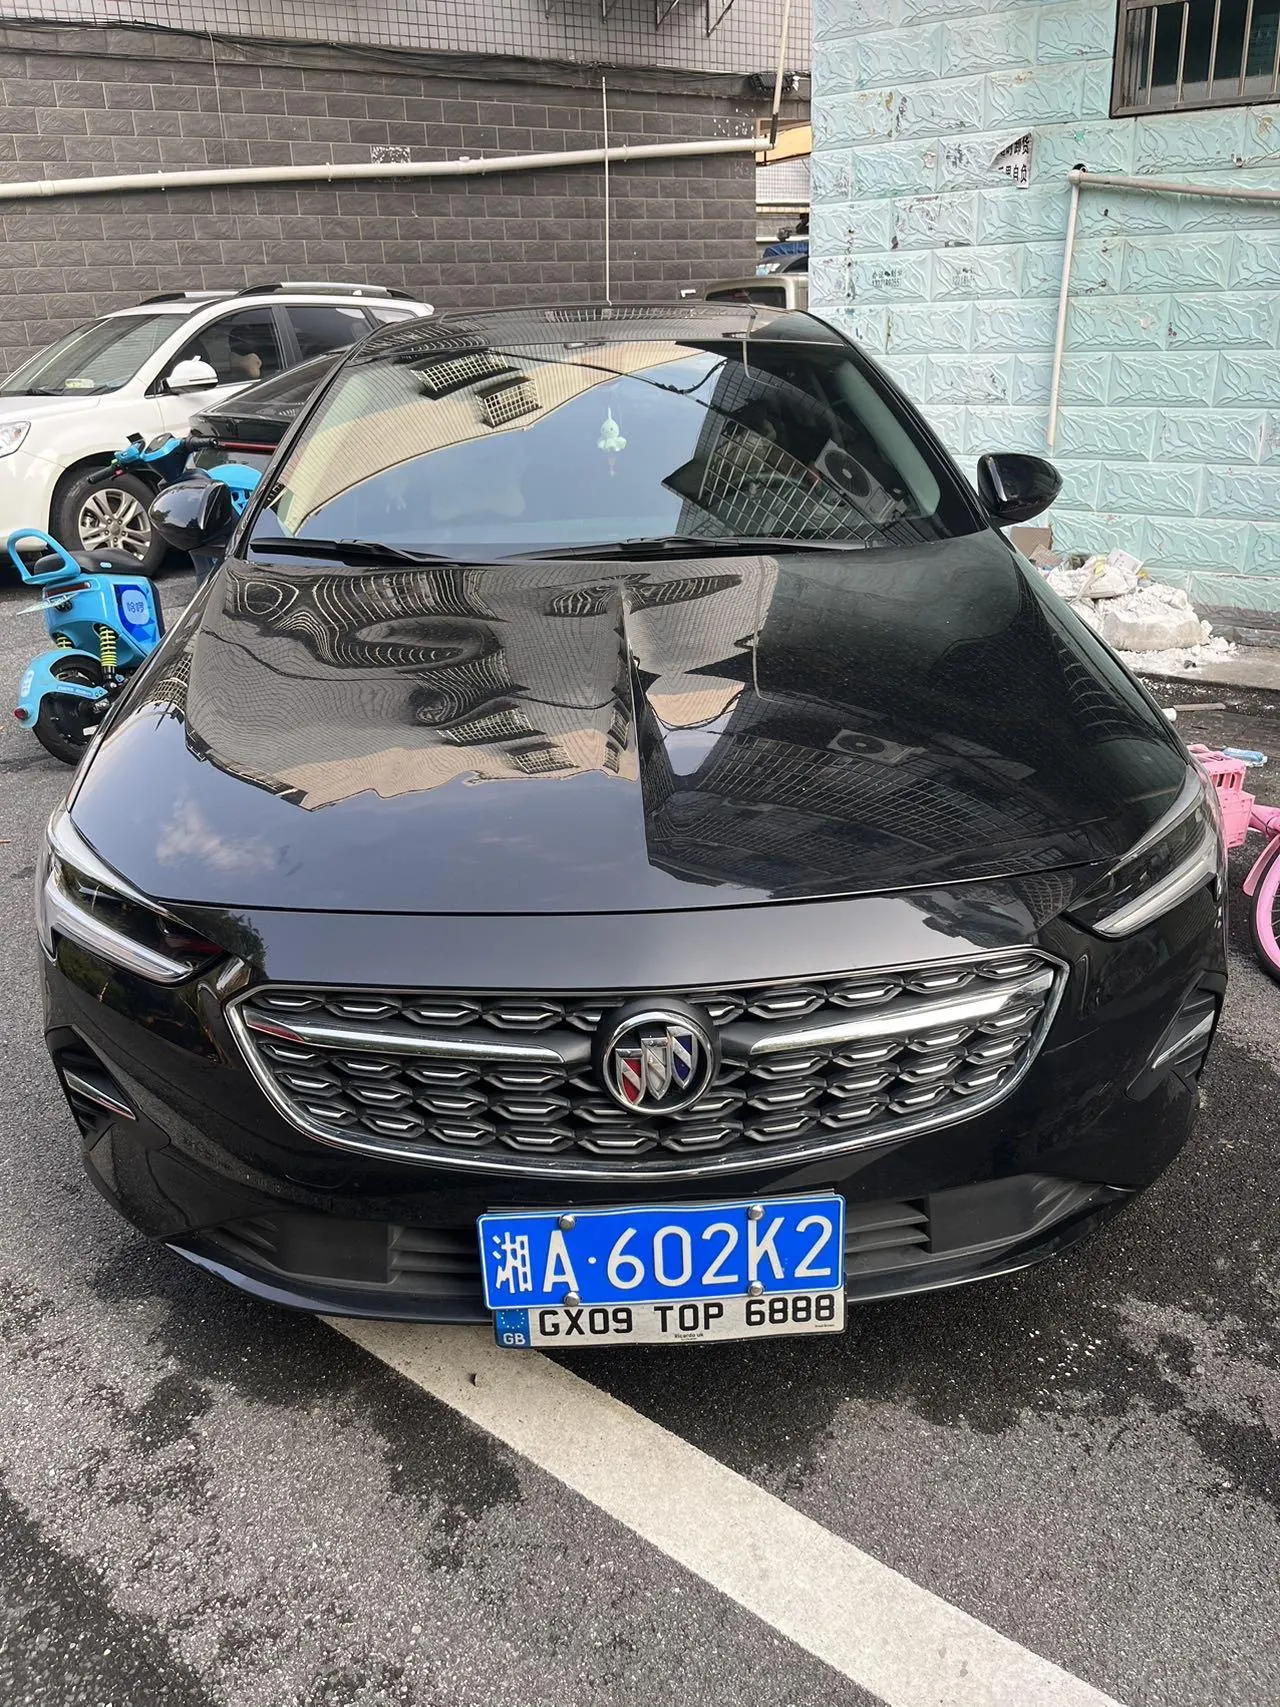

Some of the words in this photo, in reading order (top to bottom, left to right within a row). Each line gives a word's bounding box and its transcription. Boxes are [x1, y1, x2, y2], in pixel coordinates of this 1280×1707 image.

[998, 164, 1027, 182] 自负
[539, 1308, 634, 1337] GX09
[653, 1302, 724, 1333] TOP
[745, 1294, 835, 1327] 6888
[503, 1333, 526, 1345] GB
